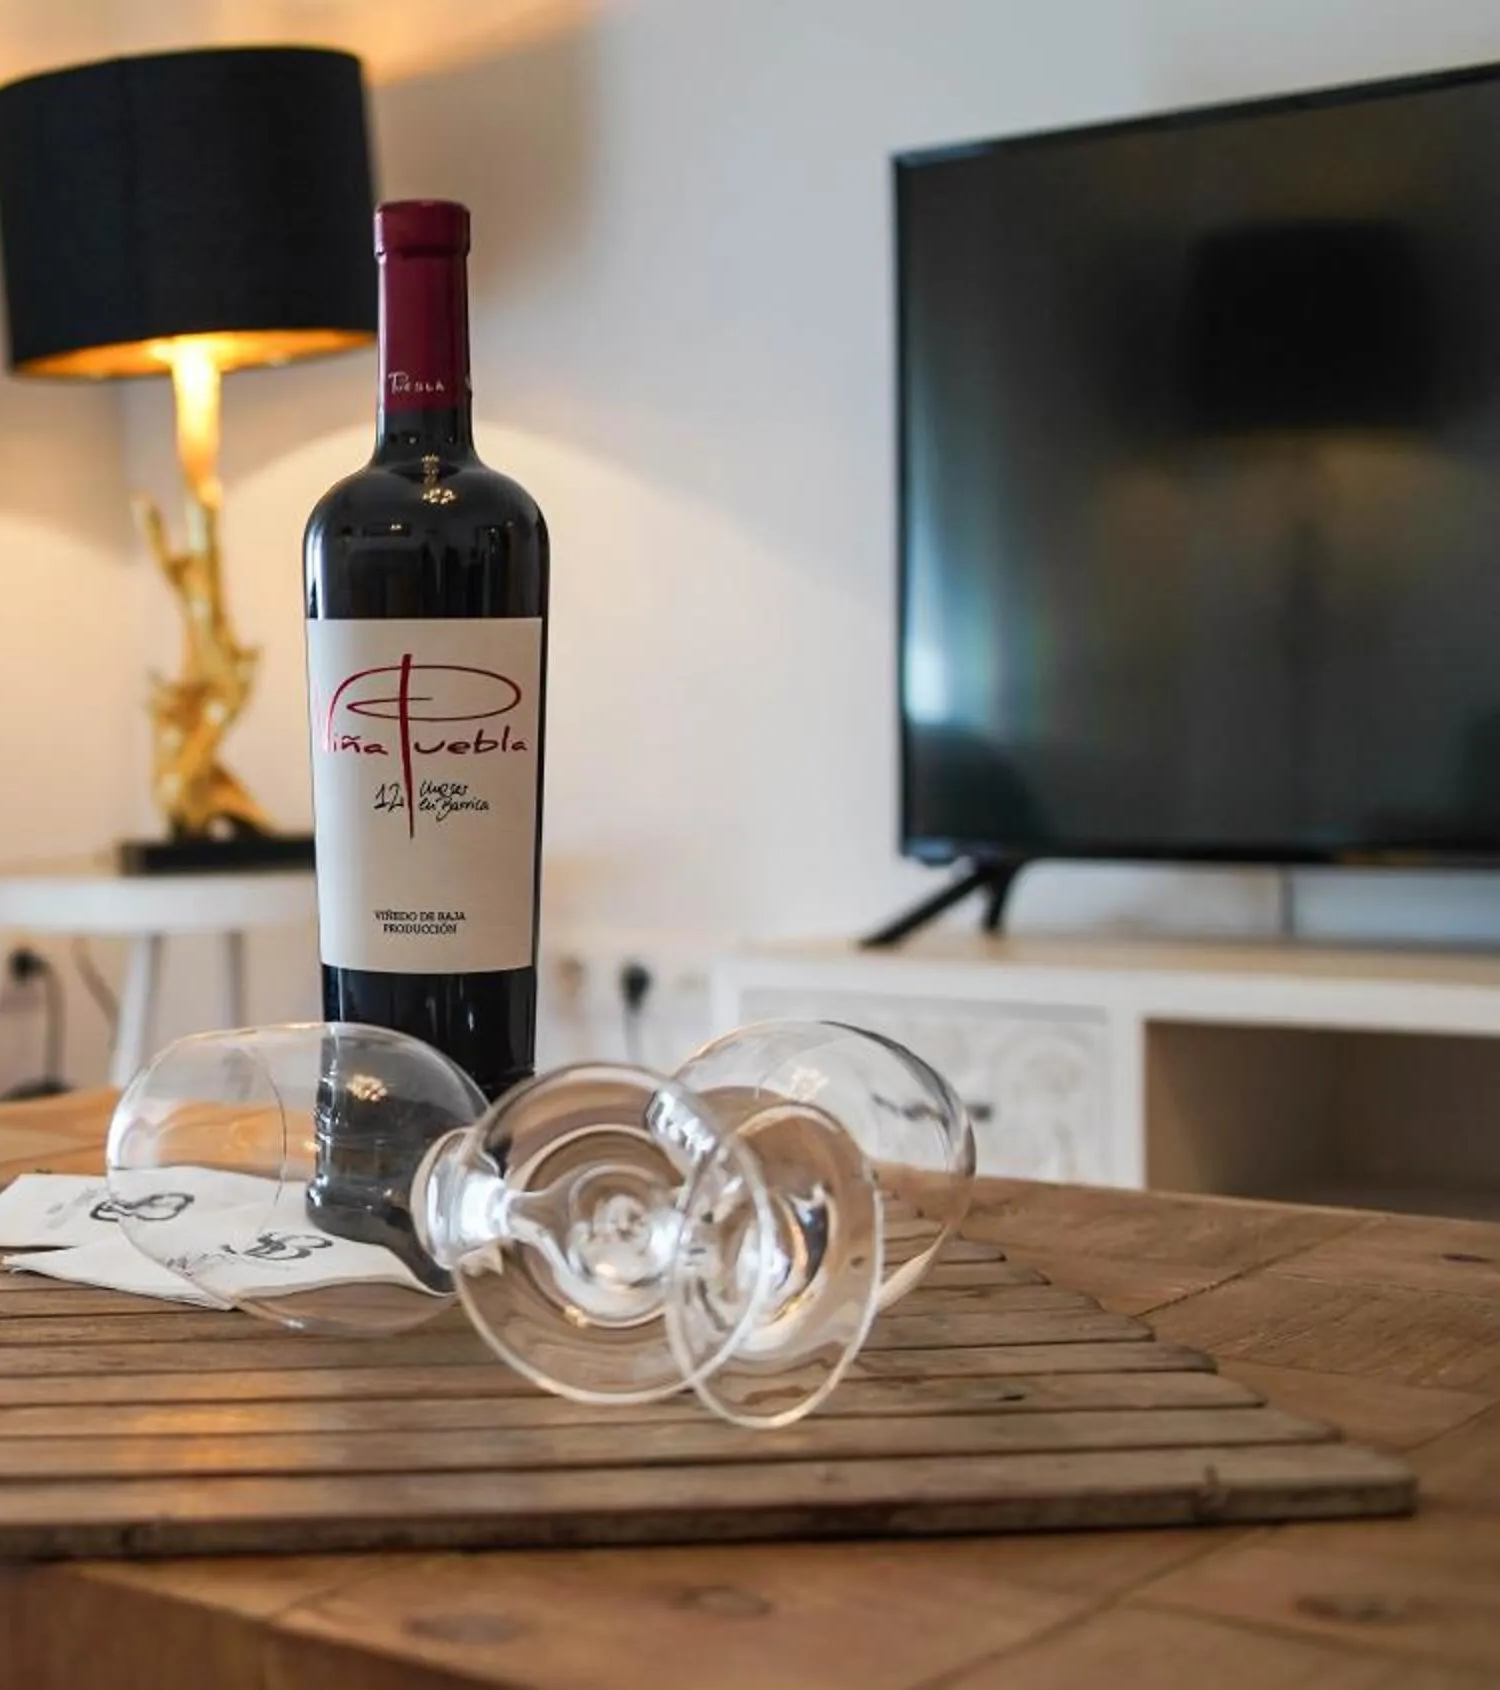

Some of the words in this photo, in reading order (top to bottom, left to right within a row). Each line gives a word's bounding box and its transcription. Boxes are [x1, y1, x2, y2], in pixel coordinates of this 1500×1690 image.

[374, 783, 404, 812] 12
[374, 909, 417, 921] VIÑEDO
[420, 911, 435, 921] DE
[437, 911, 466, 921] BAJA
[383, 922, 457, 934] PRODUCCIÓN
